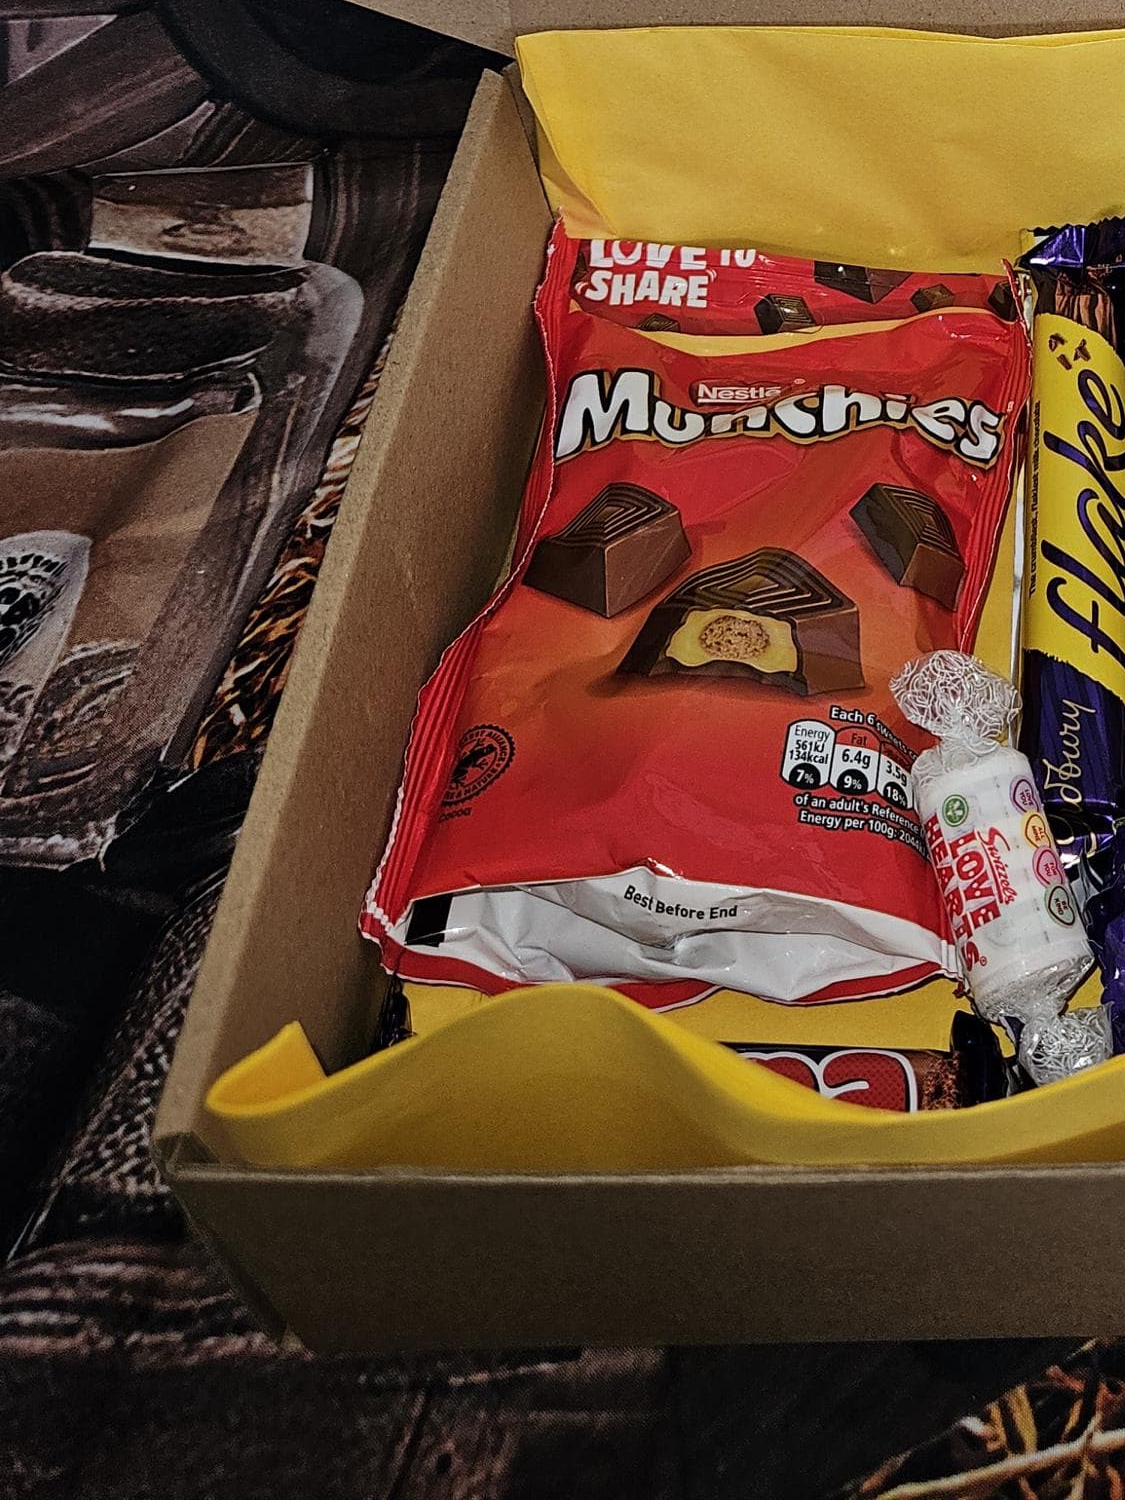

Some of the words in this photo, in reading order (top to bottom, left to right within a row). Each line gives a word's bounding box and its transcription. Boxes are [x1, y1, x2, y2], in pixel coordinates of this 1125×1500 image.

[589, 239, 708, 270] LOVE
[585, 270, 709, 308] SHARE
[553, 368, 1004, 464] Munchies
[831, 707, 864, 723] Each
[867, 714, 876, 725] 6
[794, 725, 831, 742] Energy
[851, 733, 868, 746] Fat
[789, 750, 829, 764] 134kcal
[842, 749, 871, 769] 6.4g
[796, 770, 814, 784] 7%
[844, 776, 862, 790] 9%
[886, 761, 908, 787] 3.5g
[795, 794, 807, 805] of
[811, 798, 826, 809] an
[829, 799, 869, 813] adult's
[872, 806, 920, 834] Reference
[800, 811, 842, 829] Energy
[844, 819, 865, 830] per
[868, 820, 898, 838] 100g:
[976, 826, 1018, 905] Swizzels
[949, 829, 1002, 931] LOVE
[623, 884, 654, 912] Best
[655, 900, 705, 920] Before
[709, 904, 738, 920] End
